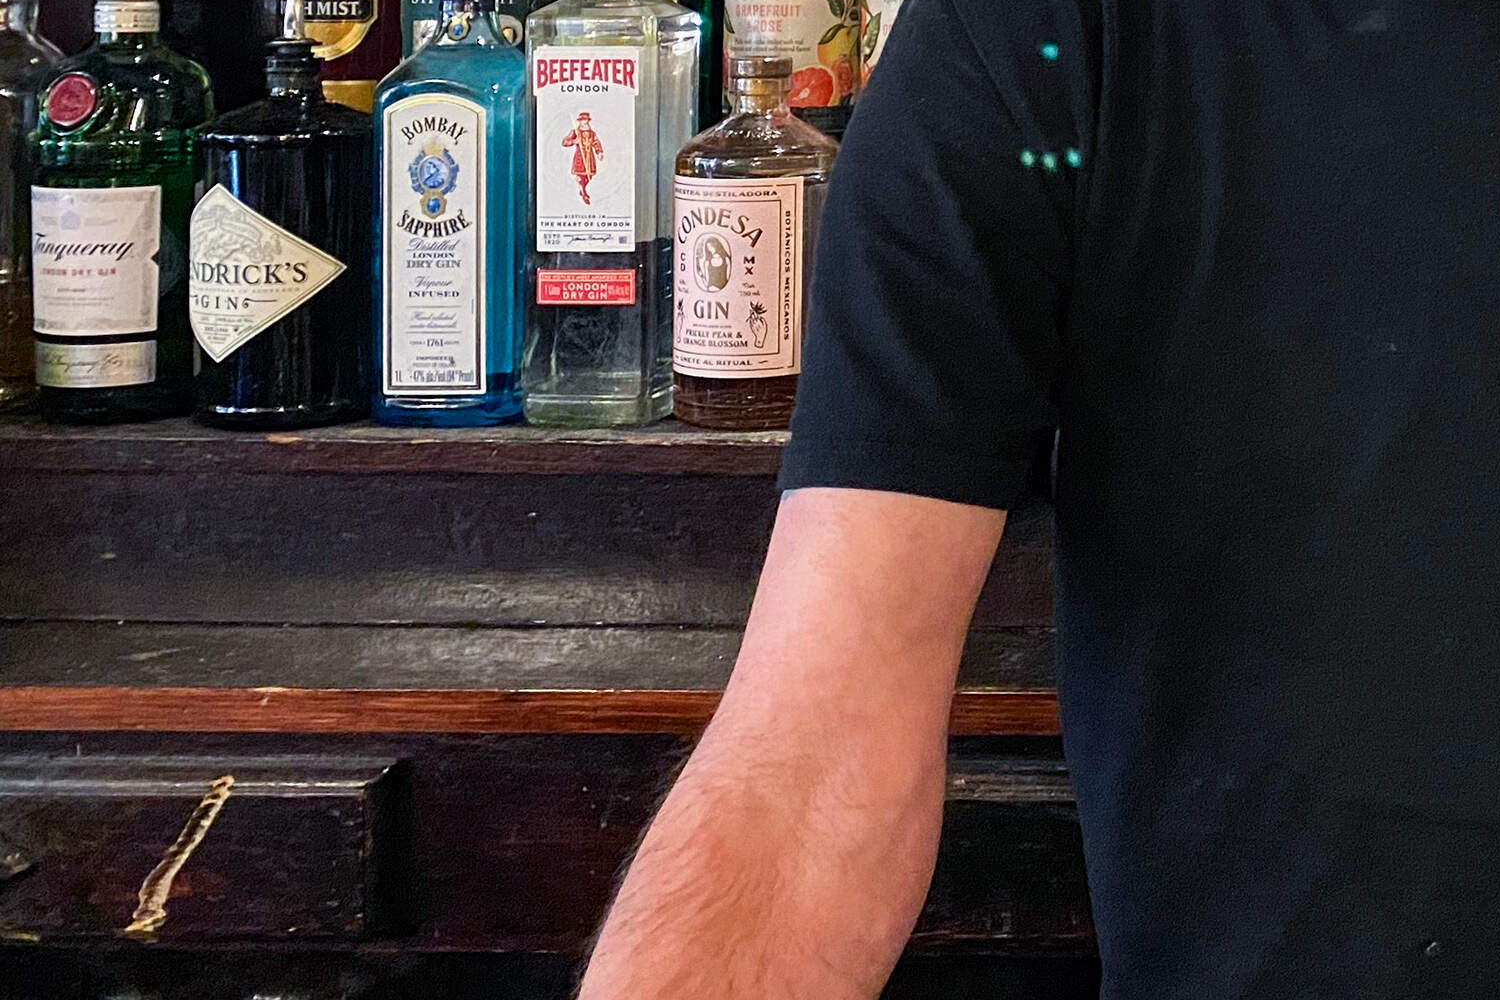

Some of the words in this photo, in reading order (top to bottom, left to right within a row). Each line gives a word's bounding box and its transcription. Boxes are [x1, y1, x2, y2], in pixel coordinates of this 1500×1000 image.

[735, 4, 801, 18] GRAPEFRUIT
[752, 20, 783, 33] ROSE
[536, 59, 635, 89] BEEFEATER
[560, 84, 609, 92] LONDON
[401, 116, 468, 145] BOMBAY
[396, 208, 473, 238] SAPPHIRE
[677, 206, 764, 248] CONDESA
[35, 232, 135, 262] Tanqueray
[408, 237, 461, 252] Distilled
[406, 260, 433, 269] DRY
[435, 260, 462, 269] GIN
[190, 260, 309, 286] NDRICK'S
[562, 282, 609, 291] LONDON
[408, 290, 460, 298] INFUSED
[562, 291, 584, 300] DRY
[587, 291, 609, 300] GIN
[201, 294, 239, 310] GIN
[783, 277, 791, 341] MEXICANOS
[693, 300, 730, 321] GIN
[685, 328, 710, 338] PRICKLY
[711, 330, 733, 339] PEAR
[735, 331, 743, 339] &
[683, 338, 706, 347] ORANGE
[707, 340, 749, 348] BLOSSOM
[716, 359, 753, 367] RITUAL
